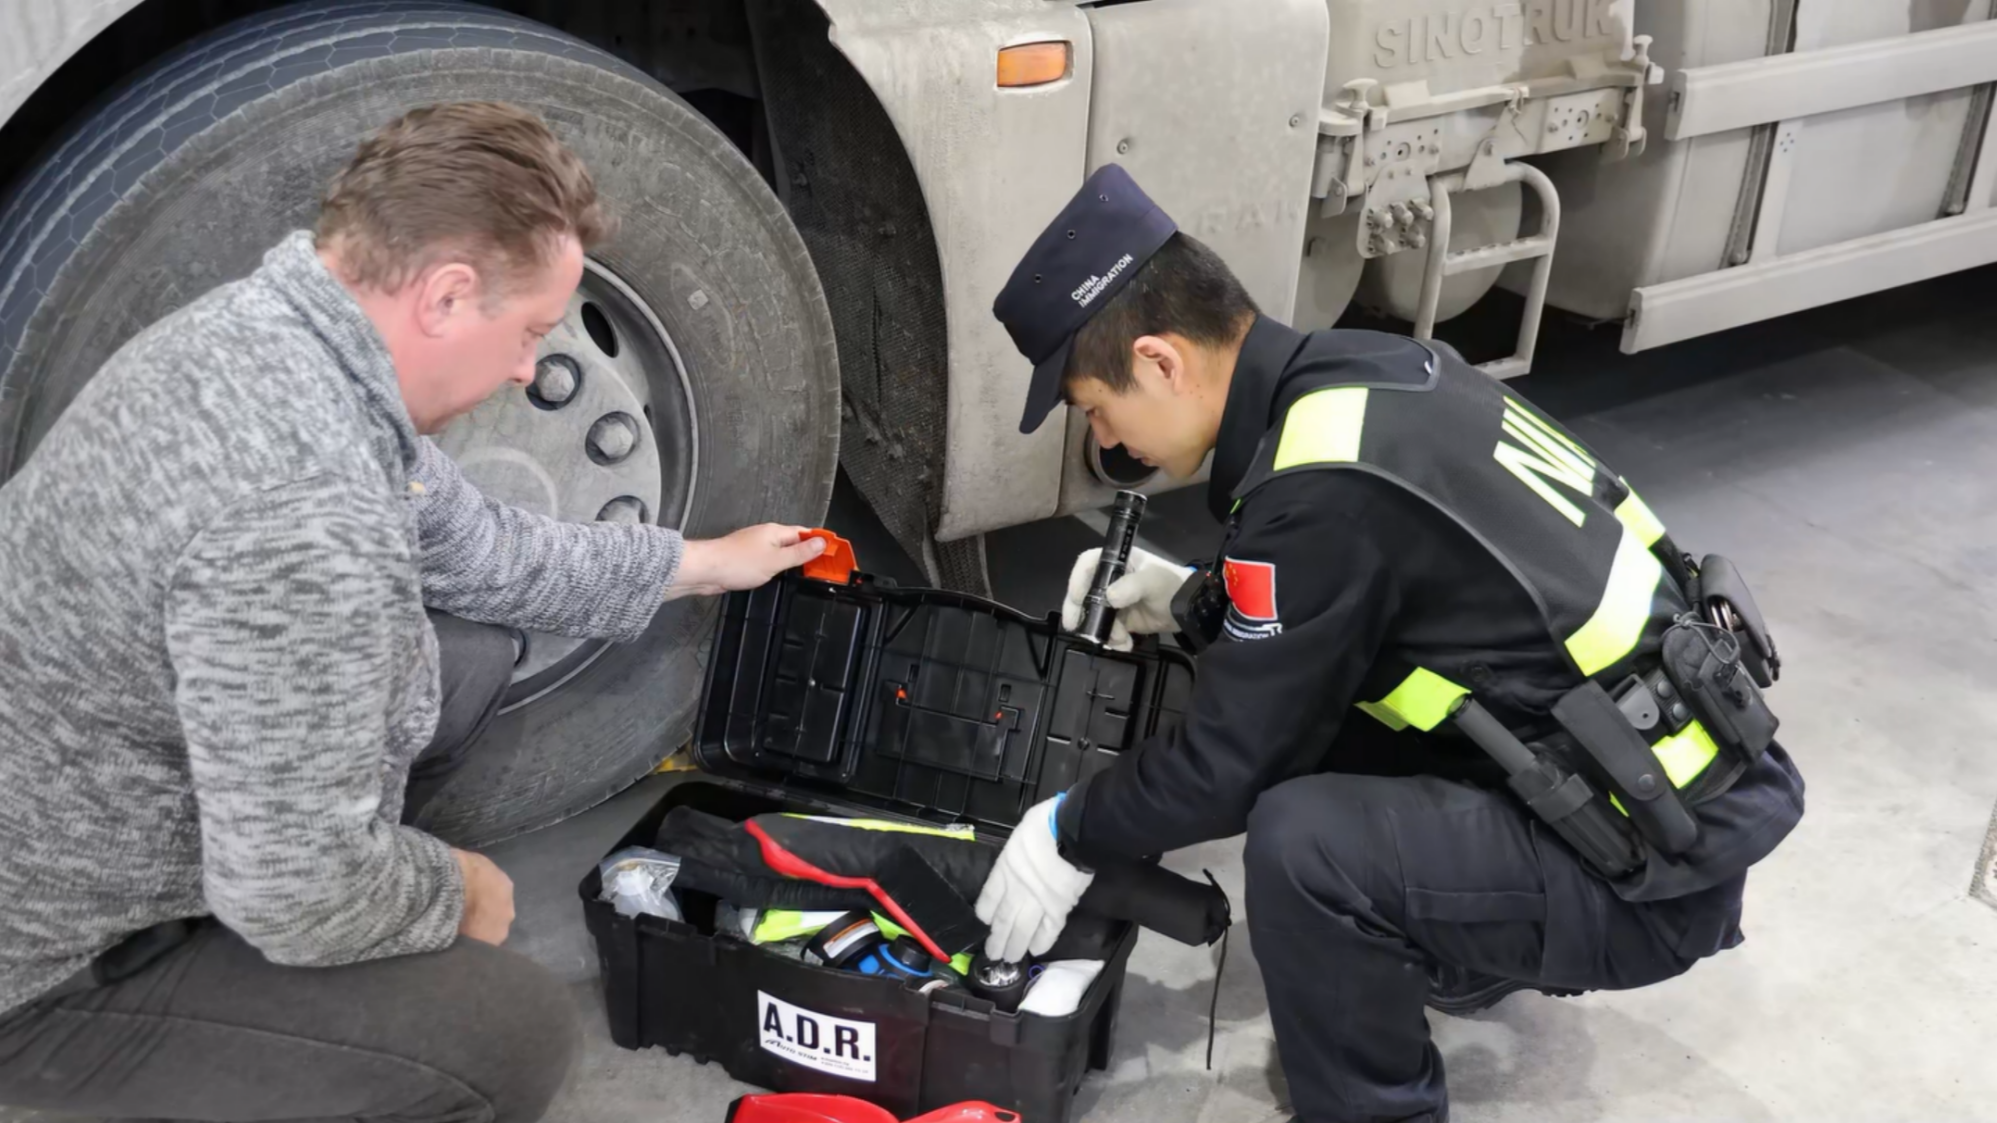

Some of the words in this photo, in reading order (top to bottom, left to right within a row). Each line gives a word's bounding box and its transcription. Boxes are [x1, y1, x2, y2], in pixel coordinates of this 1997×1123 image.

[1071, 274, 1100, 300] CHINA
[1078, 253, 1134, 308] IMMIGRATION
[763, 1002, 871, 1062] A.D.R.
